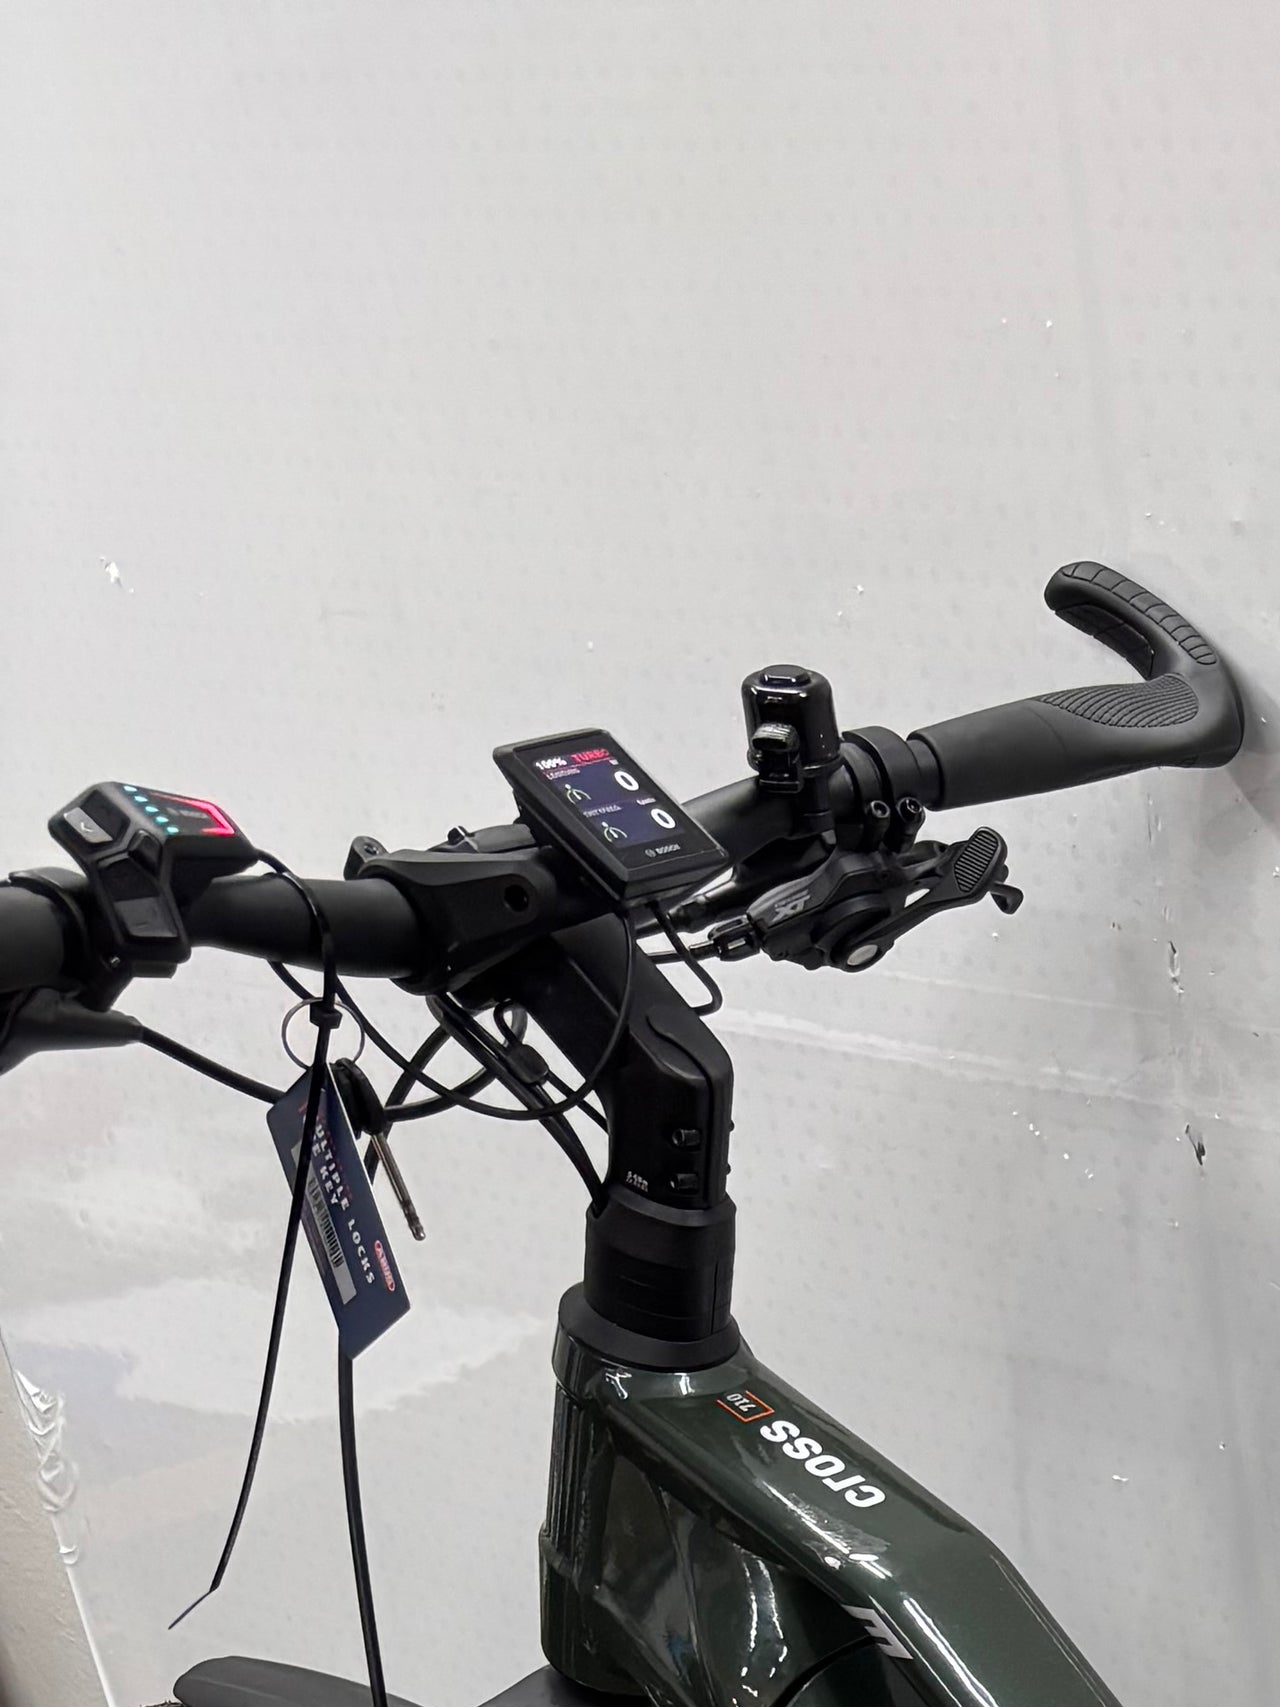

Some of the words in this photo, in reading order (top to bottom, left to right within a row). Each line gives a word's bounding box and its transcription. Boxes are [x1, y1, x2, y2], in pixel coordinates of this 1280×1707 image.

[571, 748, 610, 763] TURBO
[614, 771, 639, 791] 0
[651, 808, 676, 829] 0
[304, 1114, 350, 1211] ULTIPLE
[347, 1219, 375, 1284] LOCKS
[319, 1165, 338, 1205] KEY
[759, 1420, 886, 1508] cross
